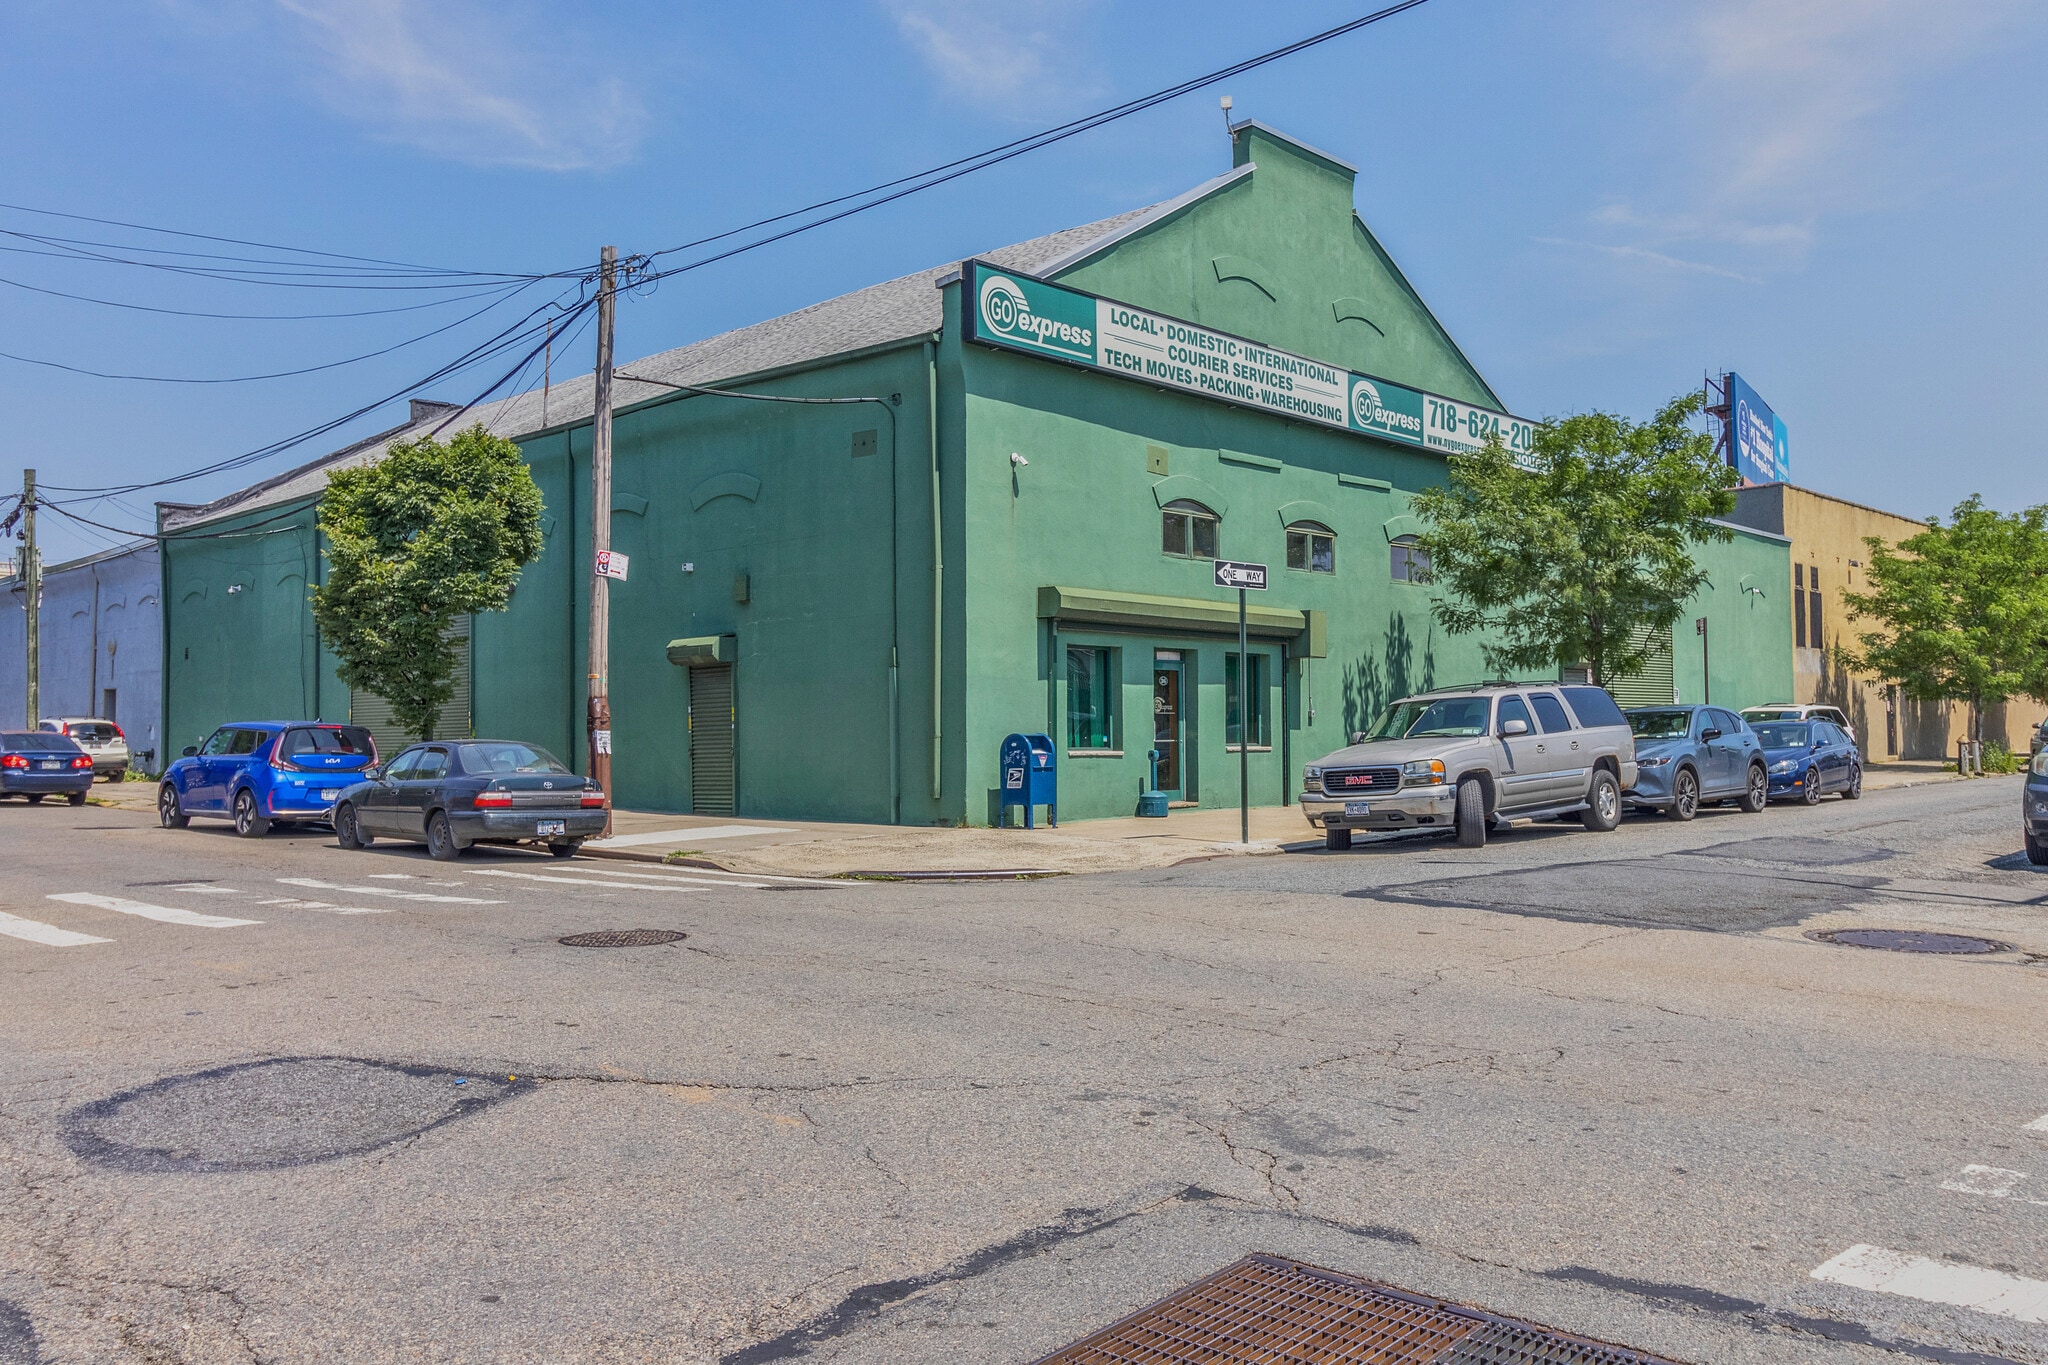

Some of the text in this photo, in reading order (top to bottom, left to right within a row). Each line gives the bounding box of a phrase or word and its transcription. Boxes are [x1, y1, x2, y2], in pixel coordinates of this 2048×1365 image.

[990, 296, 1013, 325] GO
[1018, 313, 1092, 347] express
[1110, 307, 1339, 386] LOCAL DOMESTIC INTERNATIONAL
[1168, 344, 1293, 391] COURIER SERVICES
[1104, 348, 1343, 422] TECH MOVES PACKING WAREHOUSING
[1357, 396, 1372, 416] GO
[1374, 406, 1421, 432] express
[1222, 568, 1262, 582] ONE WAY
[1345, 775, 1373, 785] GMC
